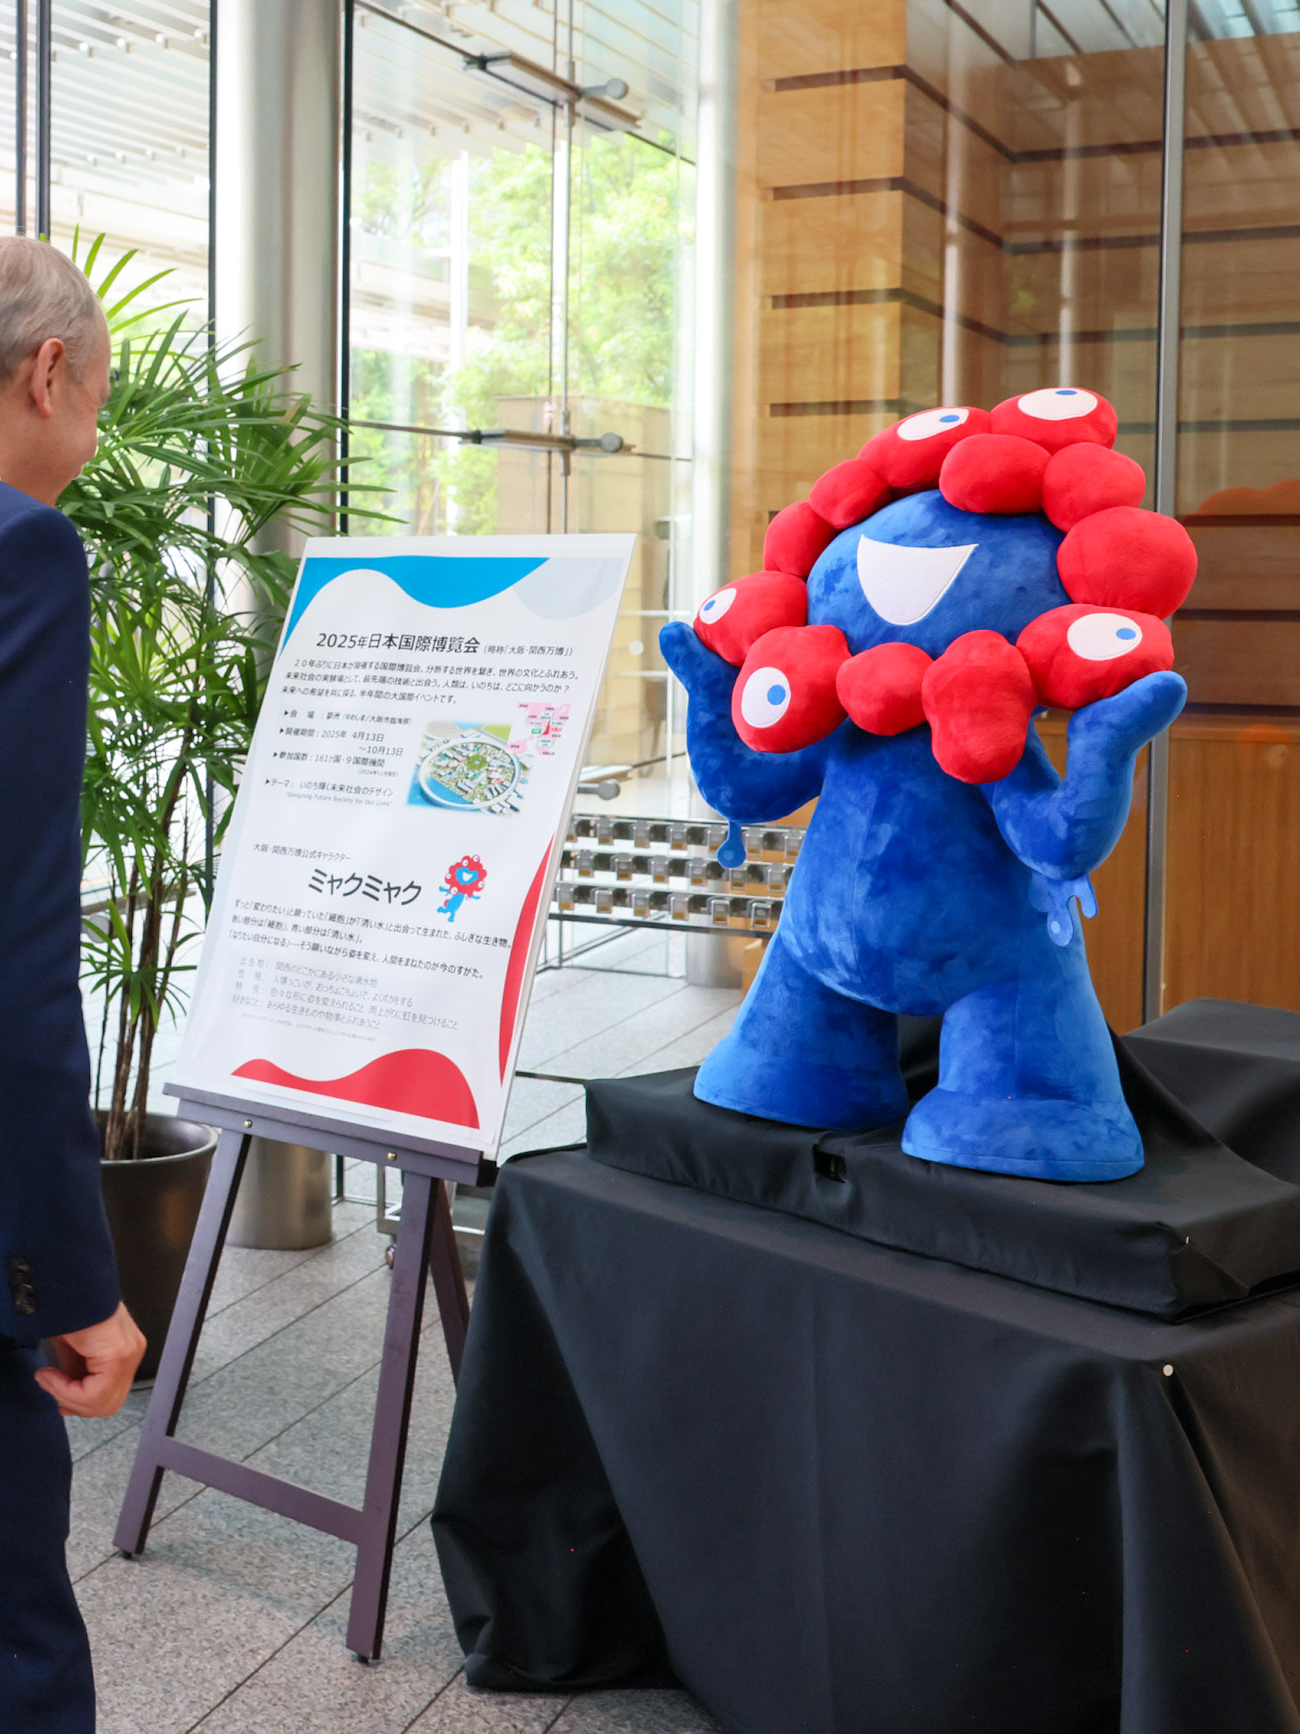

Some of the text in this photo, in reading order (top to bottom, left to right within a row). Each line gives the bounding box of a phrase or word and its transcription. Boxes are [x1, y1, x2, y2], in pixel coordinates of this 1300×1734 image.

[316, 633, 480, 654] 2025年日本国際博覧会
[308, 868, 422, 905] ミャクミャク
